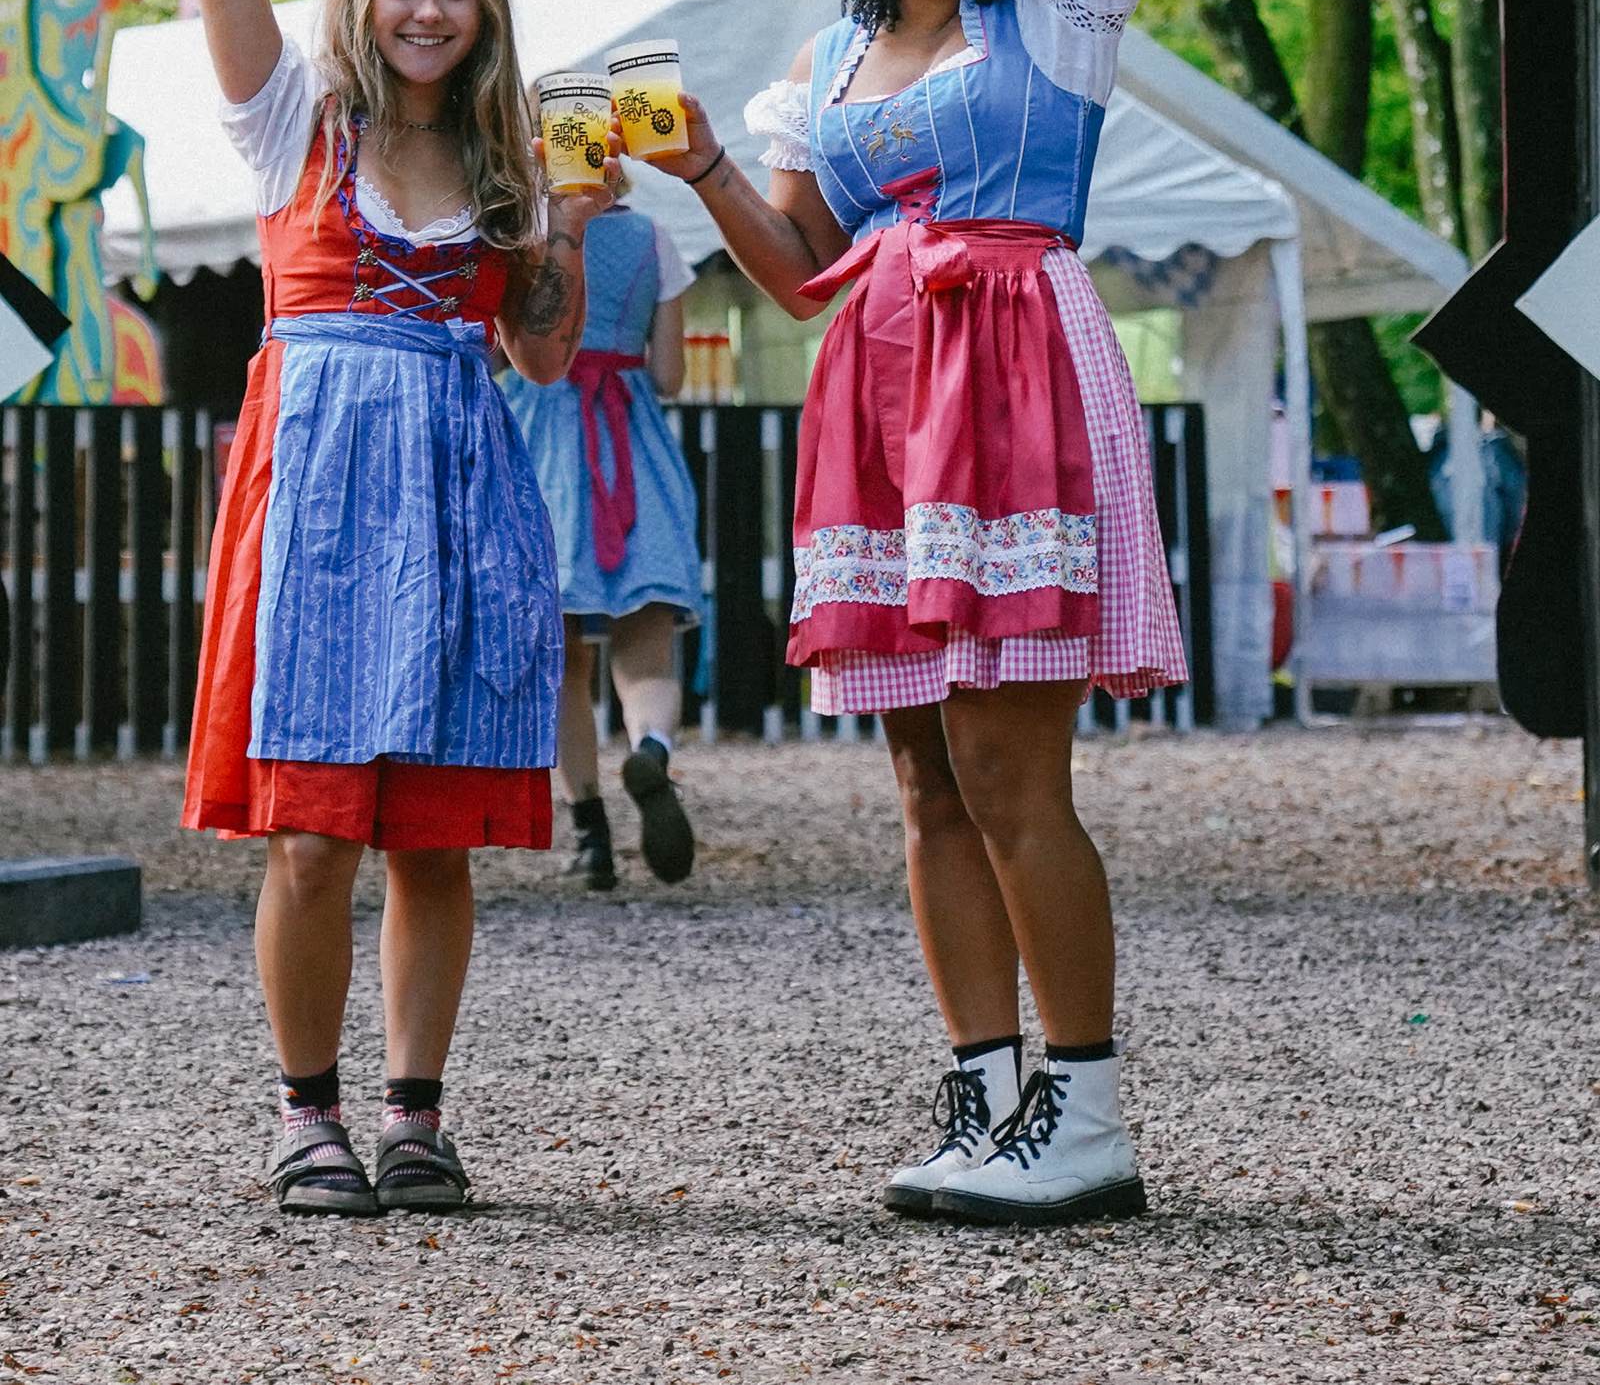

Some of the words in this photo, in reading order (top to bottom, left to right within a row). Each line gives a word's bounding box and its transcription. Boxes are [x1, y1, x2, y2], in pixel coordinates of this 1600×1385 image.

[618, 91, 649, 110] STOKE
[620, 103, 656, 121] TRAVEL
[552, 122, 587, 136] STOKE
[550, 134, 592, 149] TRAVEL
